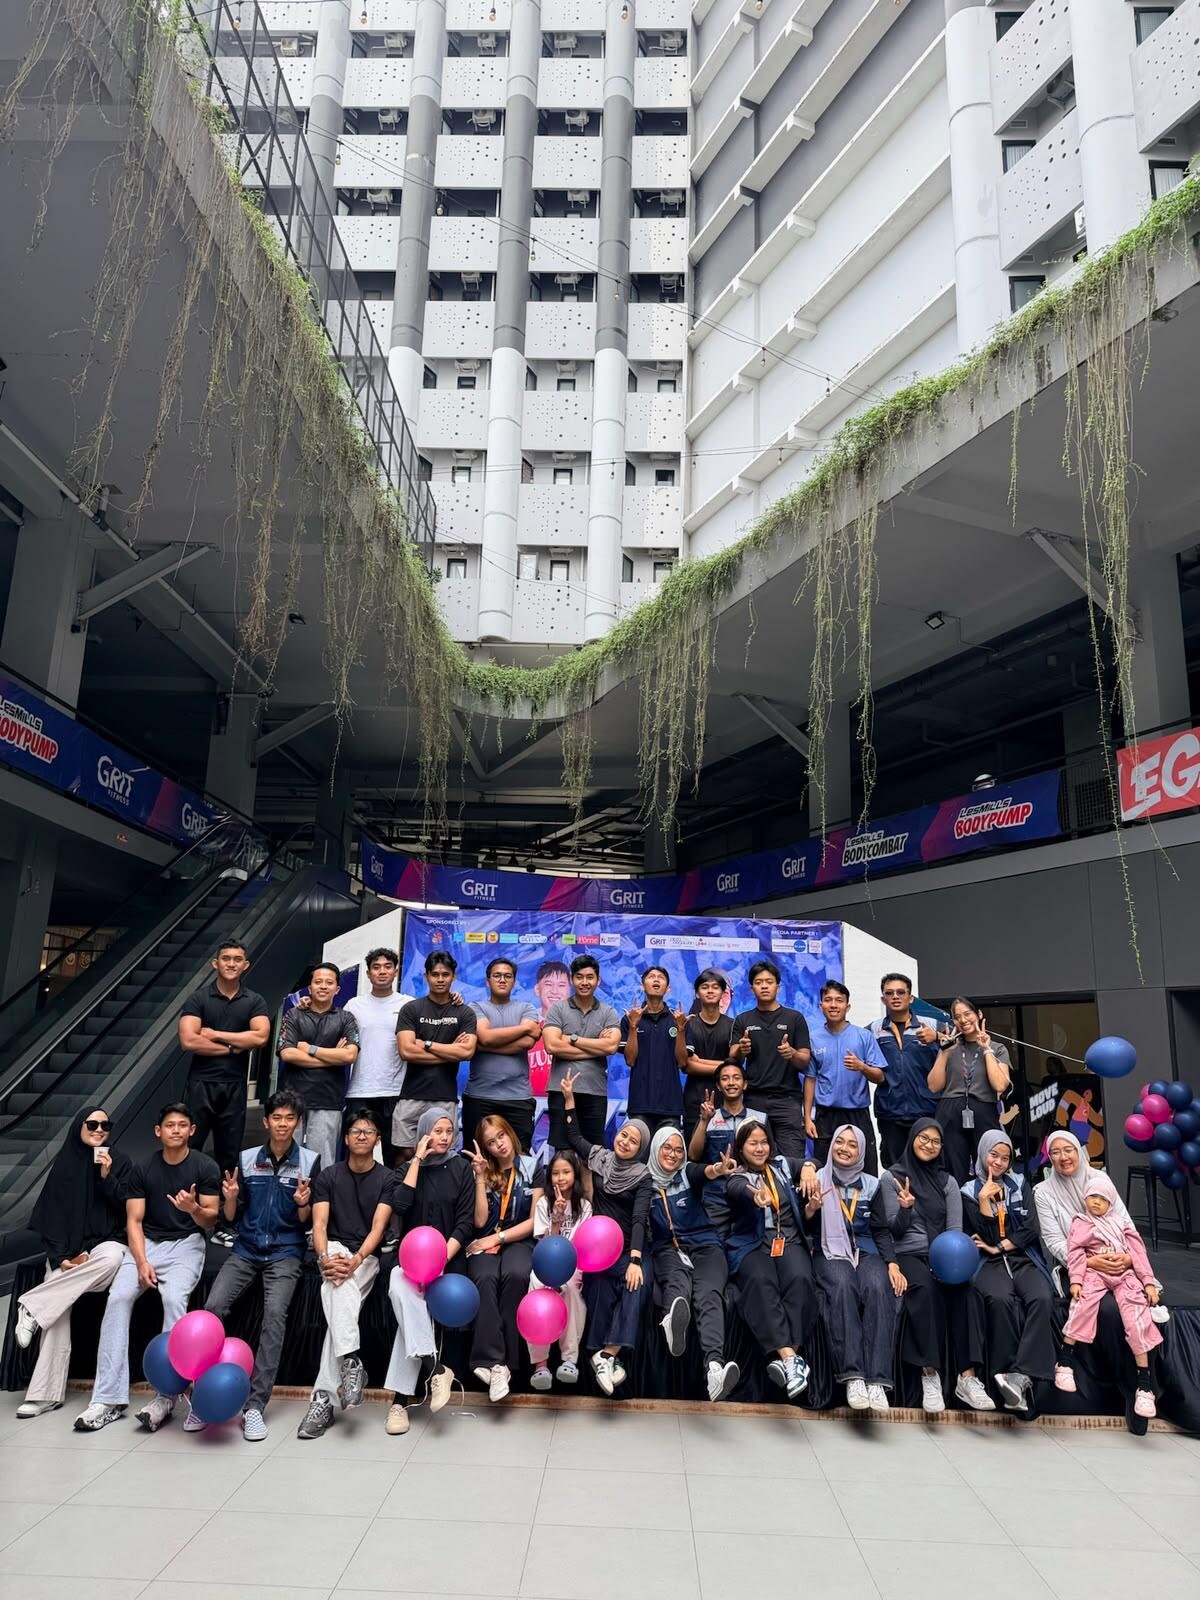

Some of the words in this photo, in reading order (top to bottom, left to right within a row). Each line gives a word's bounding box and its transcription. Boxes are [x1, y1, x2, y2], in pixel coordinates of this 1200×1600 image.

[0, 716, 57, 761] ODYPUMP
[97, 755, 134, 797] GRIT
[1118, 733, 1200, 822] LEG
[107, 789, 130, 806] FITNESS
[956, 804, 1031, 837] BODYPUMP
[843, 835, 907, 864] BODYCOMBAT
[782, 856, 806, 878] GRIT
[461, 878, 498, 897] GRIT
[717, 873, 740, 892] GRIT
[609, 888, 645, 905] GRIT
[650, 937, 667, 945] GRIT
[1029, 1082, 1058, 1109] MOVE
[1030, 1098, 1055, 1122] LOUD
